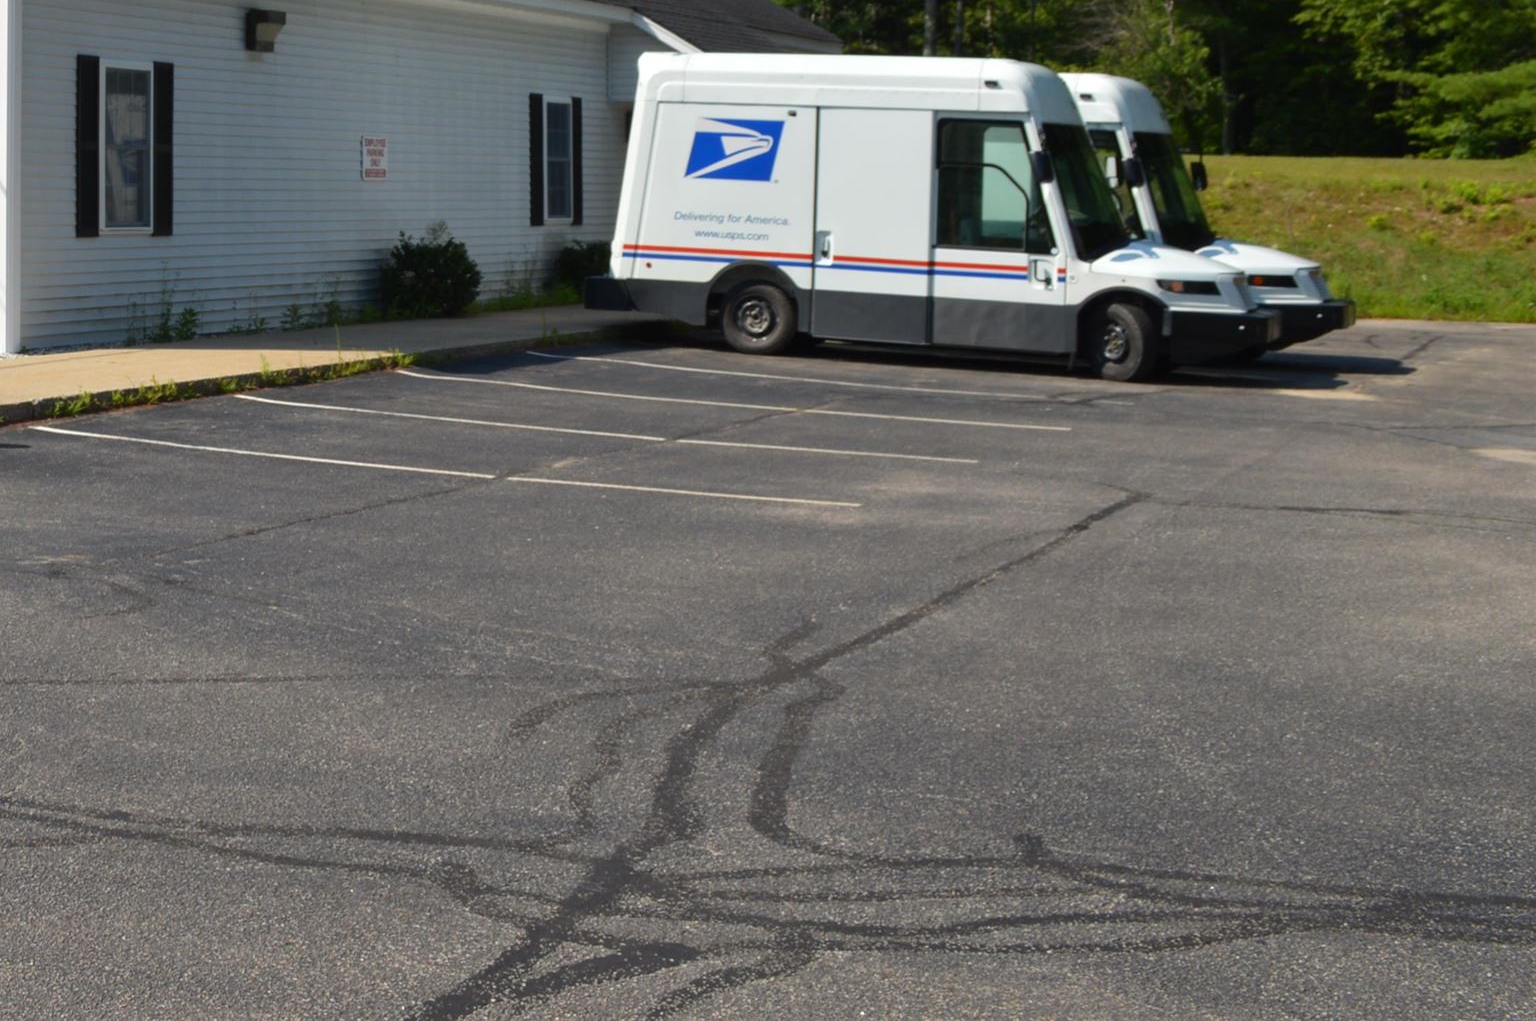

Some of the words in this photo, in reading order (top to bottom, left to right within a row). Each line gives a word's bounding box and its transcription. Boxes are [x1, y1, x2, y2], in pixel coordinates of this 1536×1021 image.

[674, 210, 725, 225] Delivering
[727, 214, 742, 224] for
[694, 230, 770, 241] www.usps.com
